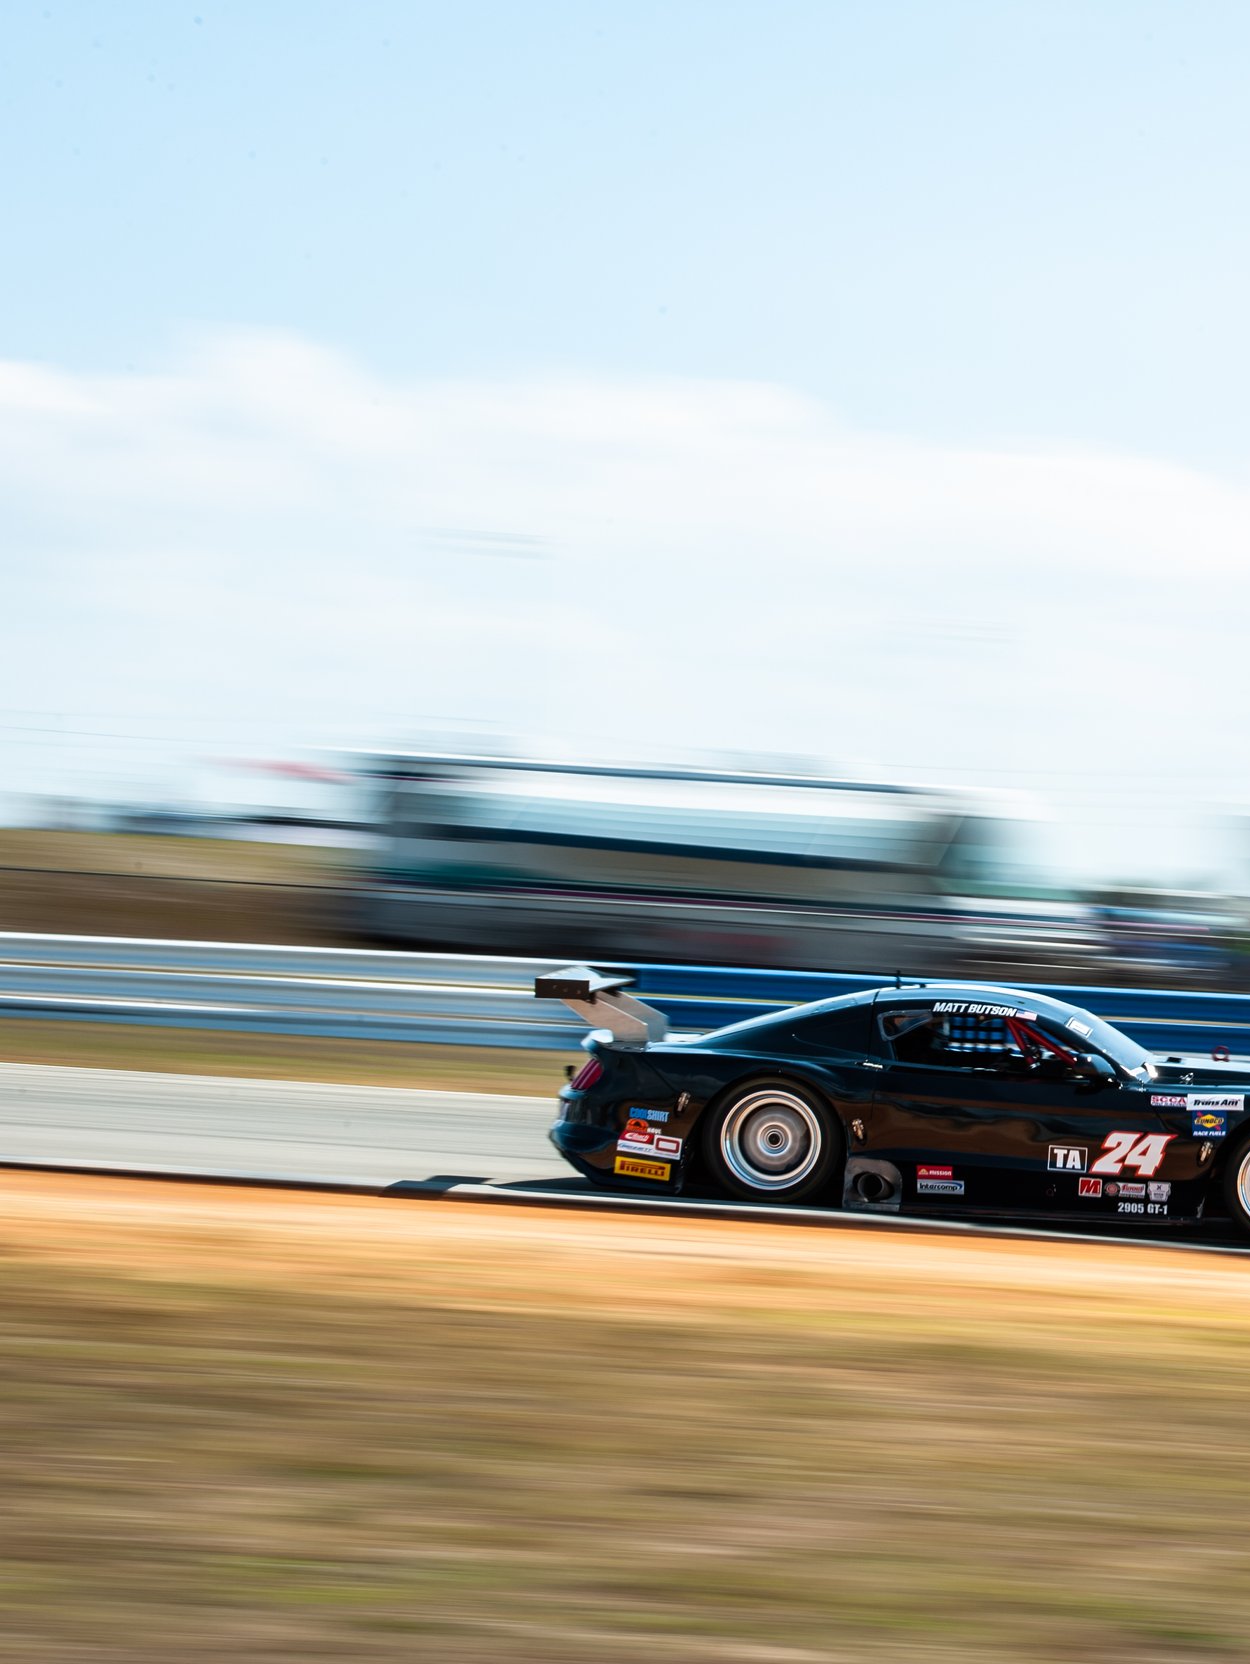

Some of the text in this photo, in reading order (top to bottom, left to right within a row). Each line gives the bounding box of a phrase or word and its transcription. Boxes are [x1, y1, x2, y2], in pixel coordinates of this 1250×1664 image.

[933, 1002, 1017, 1017] MATT BUTSON
[1152, 1096, 1187, 1104] SCCA
[1194, 1117, 1224, 1125] SUNOCO
[1053, 1148, 1082, 1170] TA
[1089, 1130, 1178, 1177] 24
[620, 1160, 666, 1176] PIRELLI
[920, 1182, 957, 1191] Intercomp
[1118, 1202, 1168, 1215] 2905 GT-1
